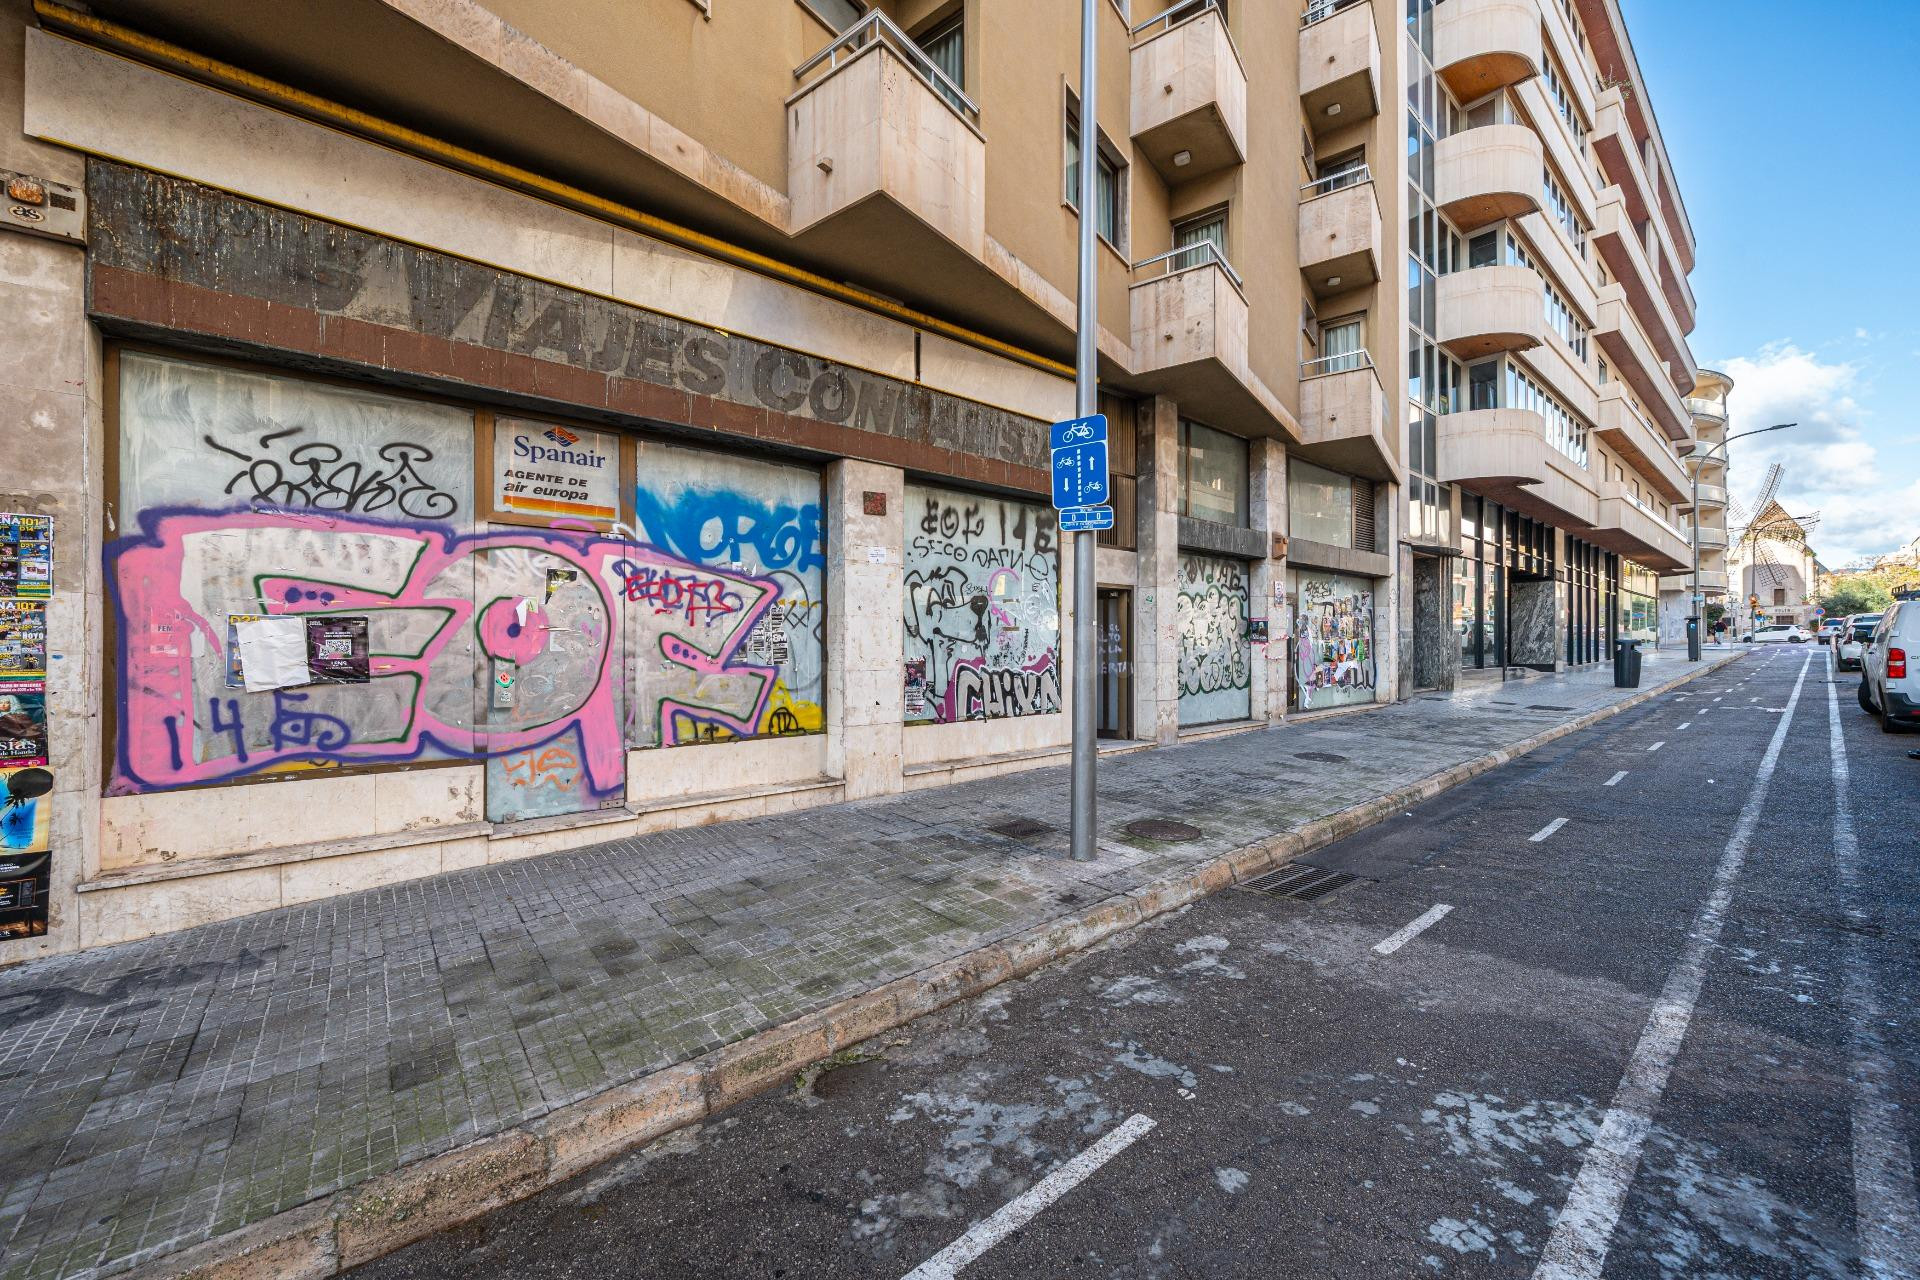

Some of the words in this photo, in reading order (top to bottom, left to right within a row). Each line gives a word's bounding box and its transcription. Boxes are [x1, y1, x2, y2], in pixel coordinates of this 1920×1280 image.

[514, 436, 606, 468] Spanair
[504, 470, 564, 484] AGENTE
[568, 478, 588, 488] DE
[504, 482, 528, 493] air
[533, 486, 588, 501] europa
